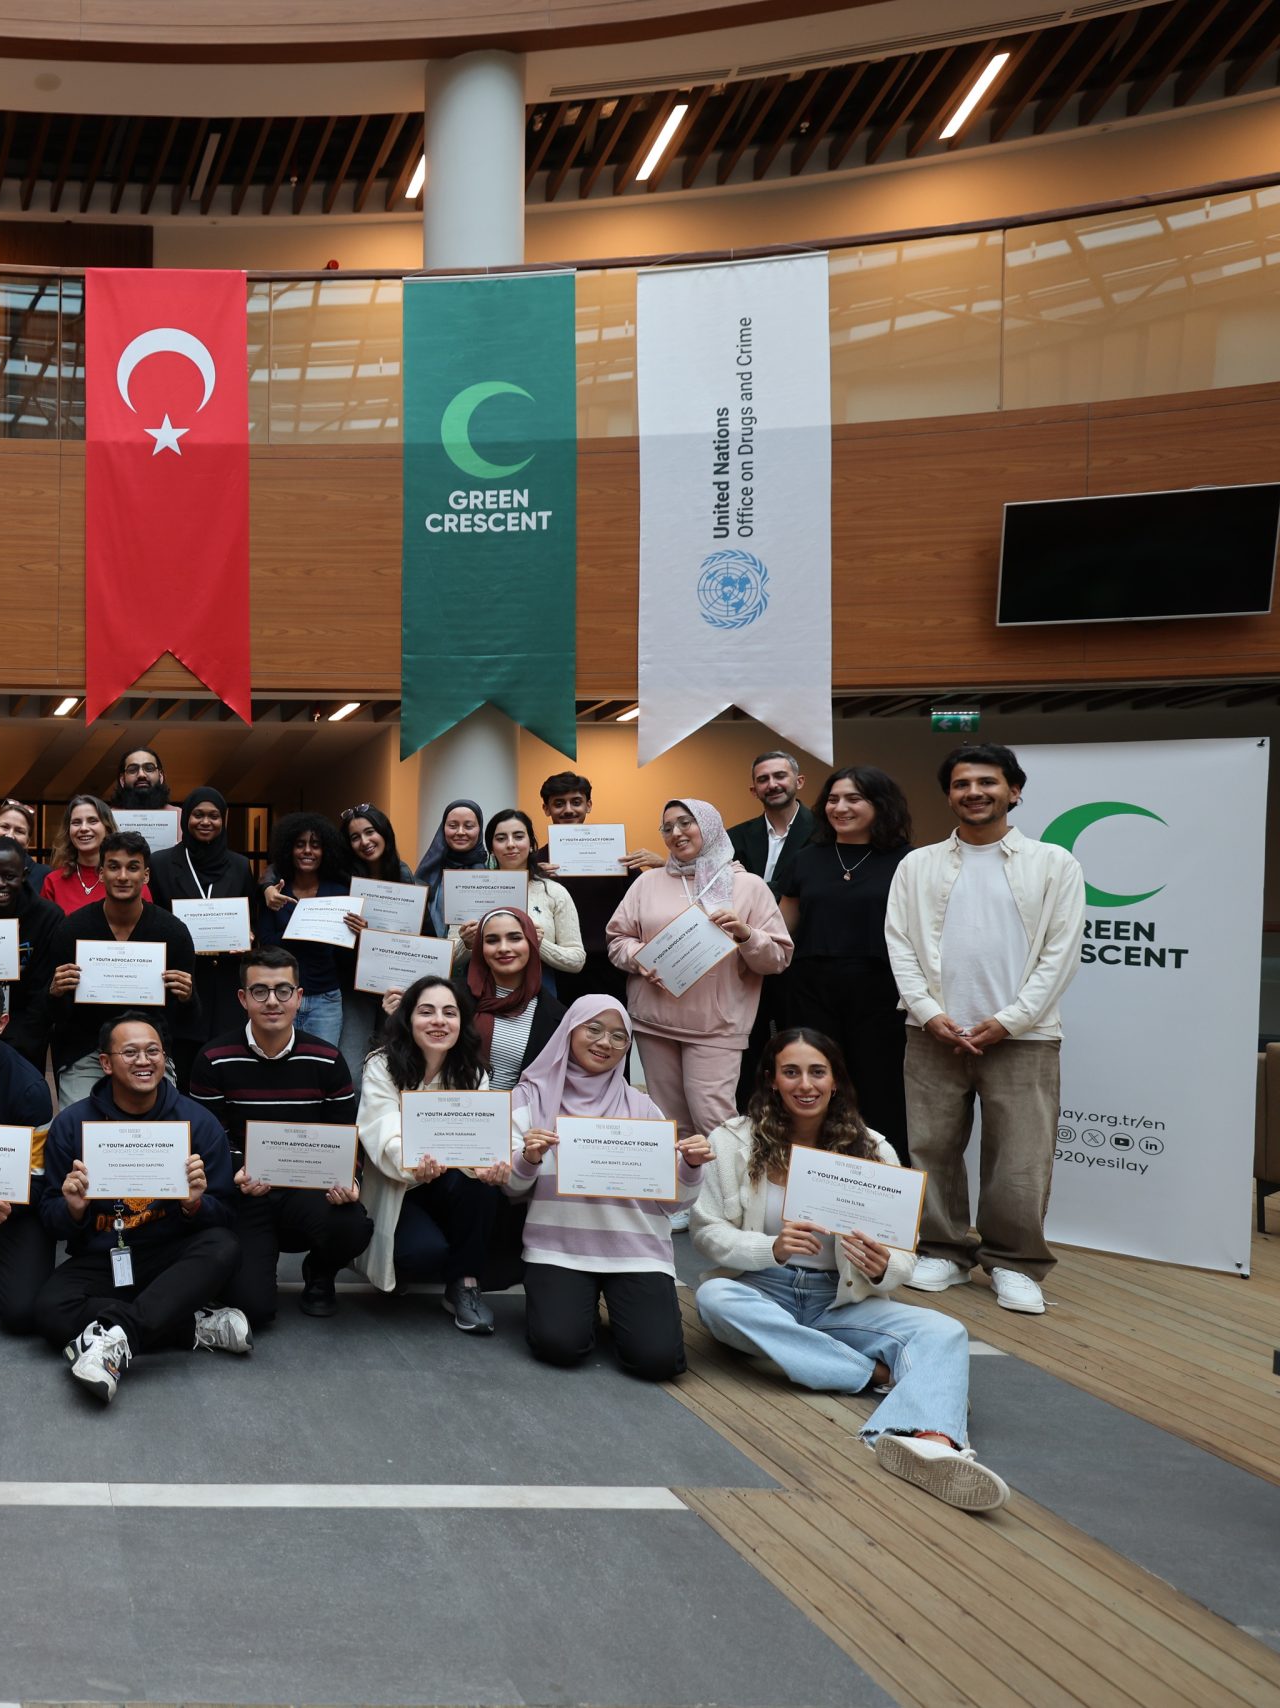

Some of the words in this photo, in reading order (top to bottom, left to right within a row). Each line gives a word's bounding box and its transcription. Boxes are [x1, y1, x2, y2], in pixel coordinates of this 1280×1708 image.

[736, 317, 752, 366] Crime
[736, 371, 753, 401] and
[712, 406, 730, 476] Nations
[737, 406, 758, 455] Drugs
[741, 460, 754, 482] on
[448, 488, 529, 510] GREEN
[712, 480, 730, 539] United
[736, 486, 754, 538] Office
[425, 511, 552, 533] CRESCENT
[1082, 919, 1155, 942] REEN
[395, 950, 420, 958] ADVOCACY
[1080, 943, 1189, 969] SCENT
[1058, 1106, 1165, 1131] lay.org.tr/en
[1053, 1148, 1149, 1175] 920yesilay
[817, 1172, 839, 1181] YOUTH
[840, 1177, 876, 1189] ADVOCACY
[878, 1185, 902, 1195] FORUM
